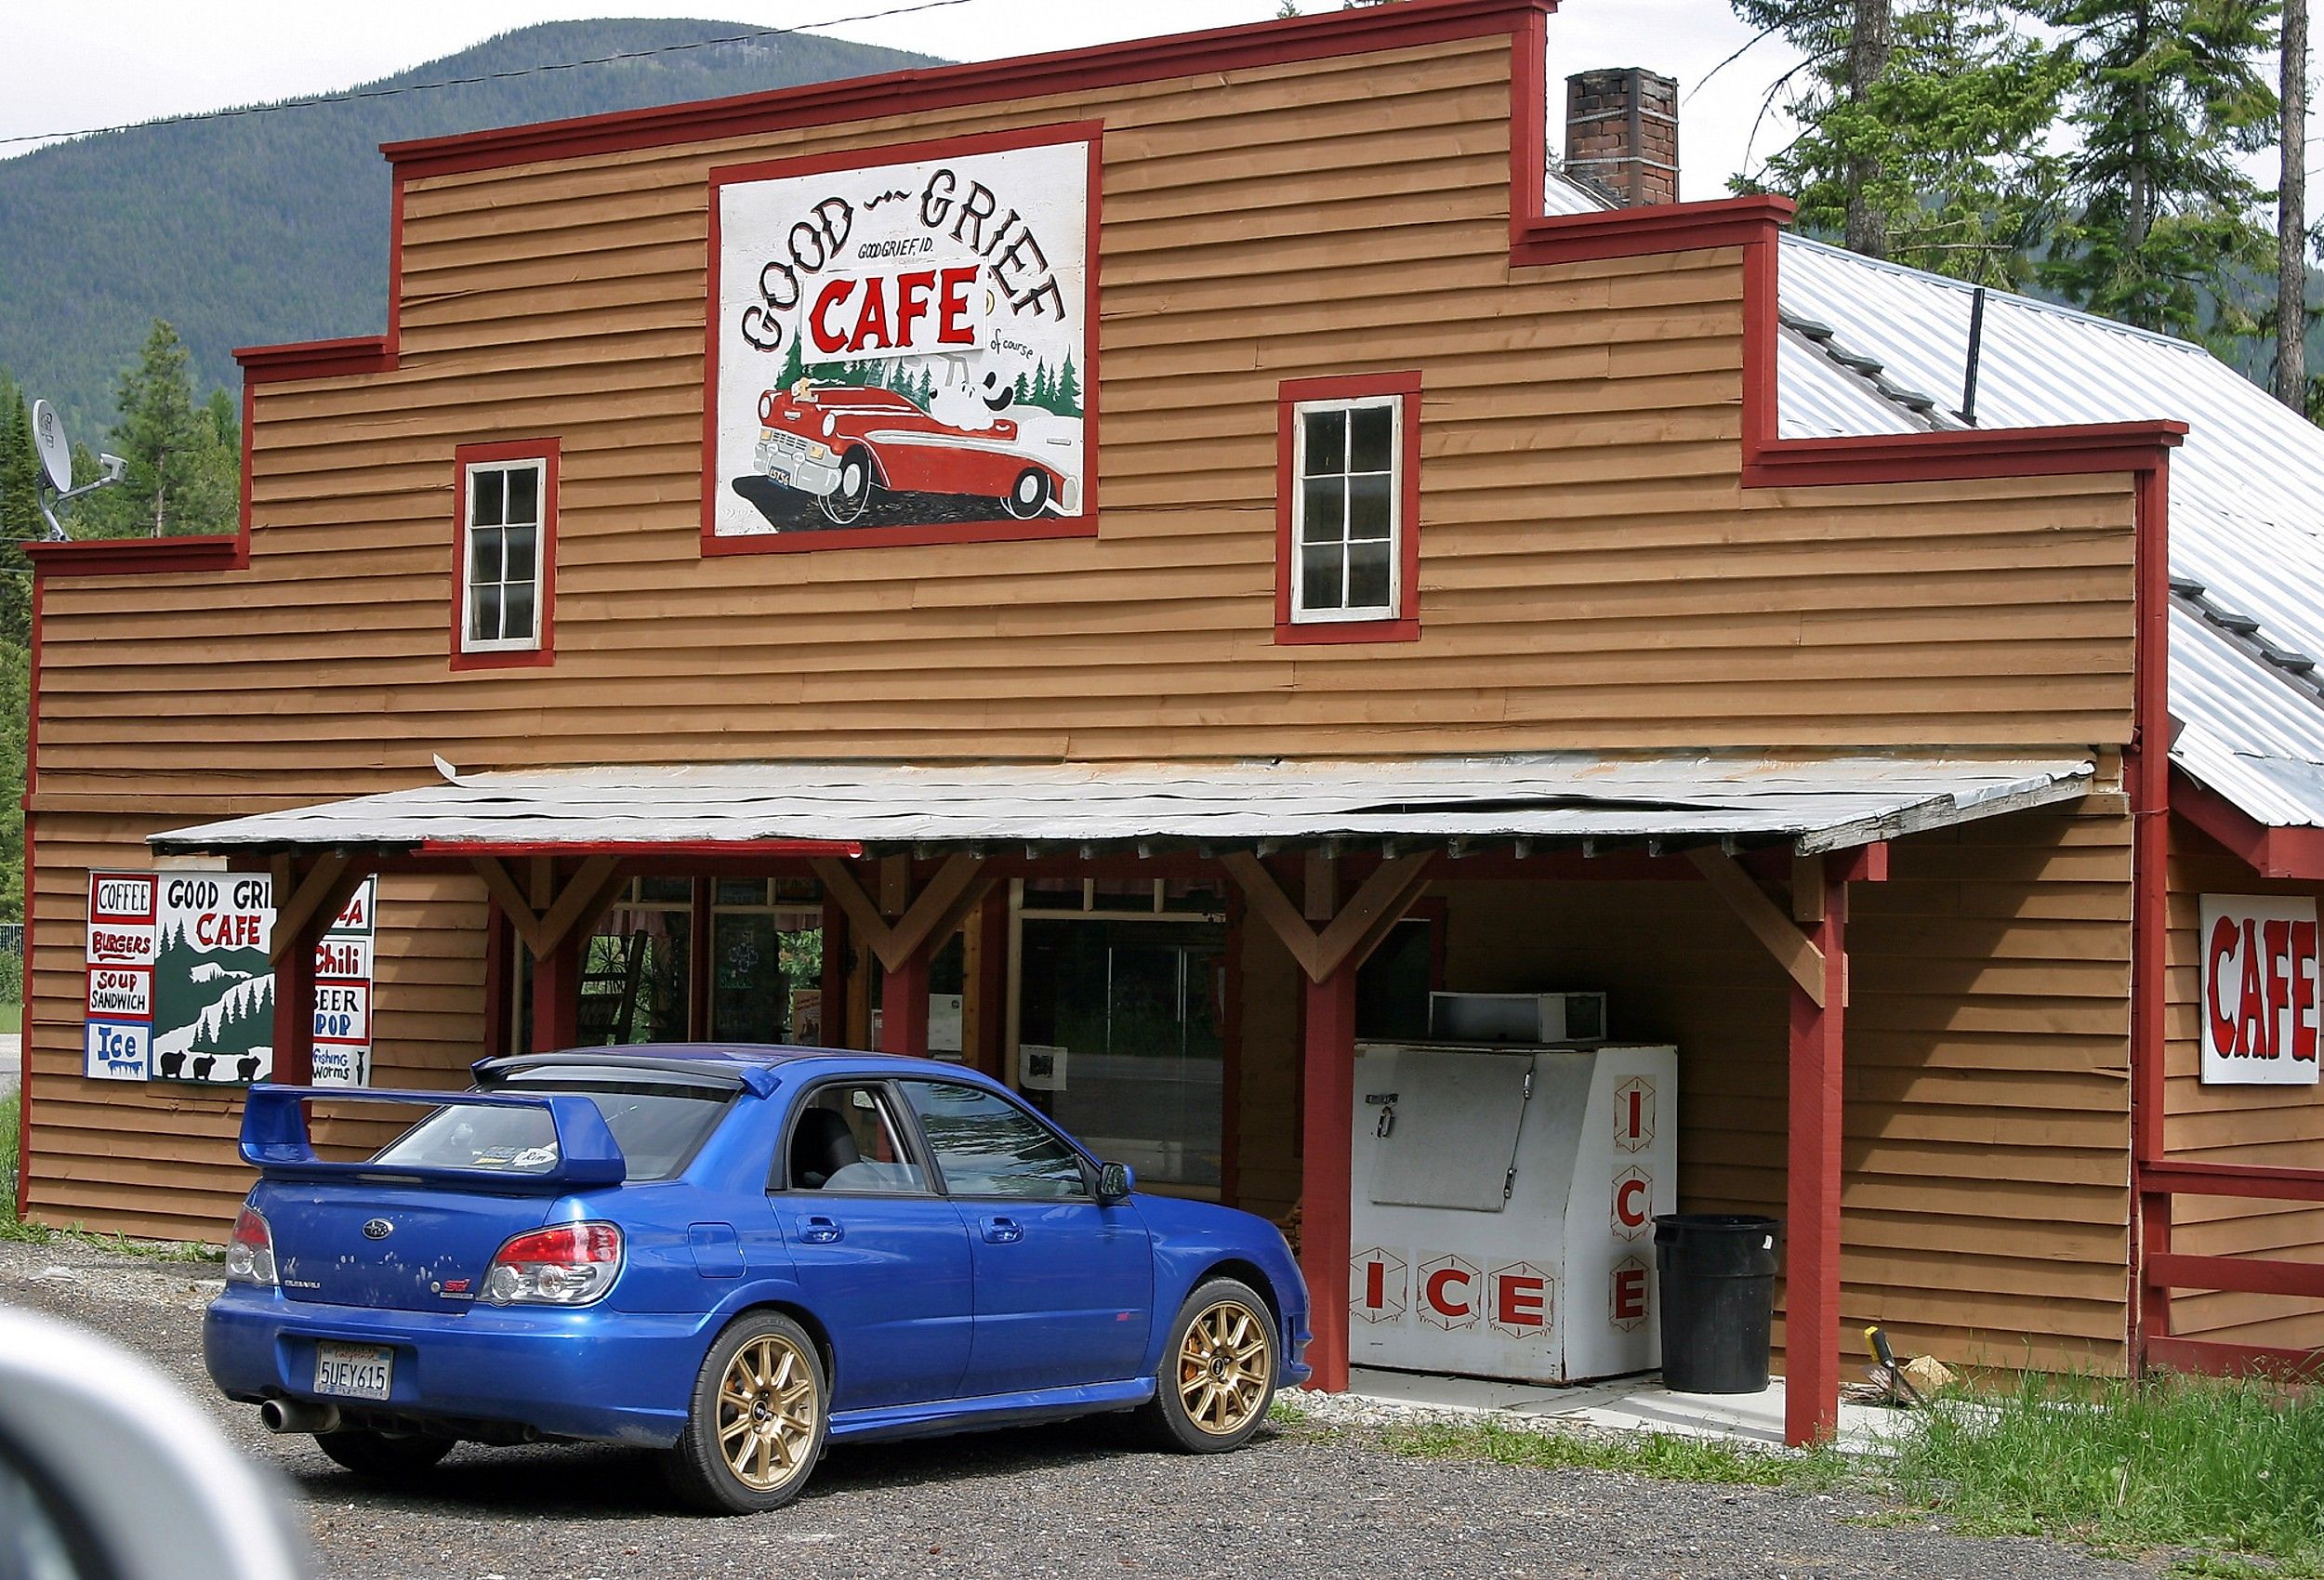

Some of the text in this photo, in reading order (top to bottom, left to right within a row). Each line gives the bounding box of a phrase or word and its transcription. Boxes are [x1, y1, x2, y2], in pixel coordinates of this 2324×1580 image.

[741, 168, 1067, 352] GOOD GRIEF
[809, 264, 982, 354] CAFE
[990, 328, 1034, 360] of course
[99, 883, 149, 911] COFFEE
[167, 878, 270, 910] GOOD GRI
[92, 930, 151, 955] BURGERS
[195, 912, 261, 946] CAFE
[314, 943, 359, 975] Chili
[91, 990, 146, 1011] SANDWICH
[2207, 915, 2317, 1062] CAFE
[314, 1013, 351, 1036] POP
[98, 1026, 137, 1060] Ice
[1366, 1260, 1544, 1326] ICE
[321, 1361, 385, 1389] 5UEY615
